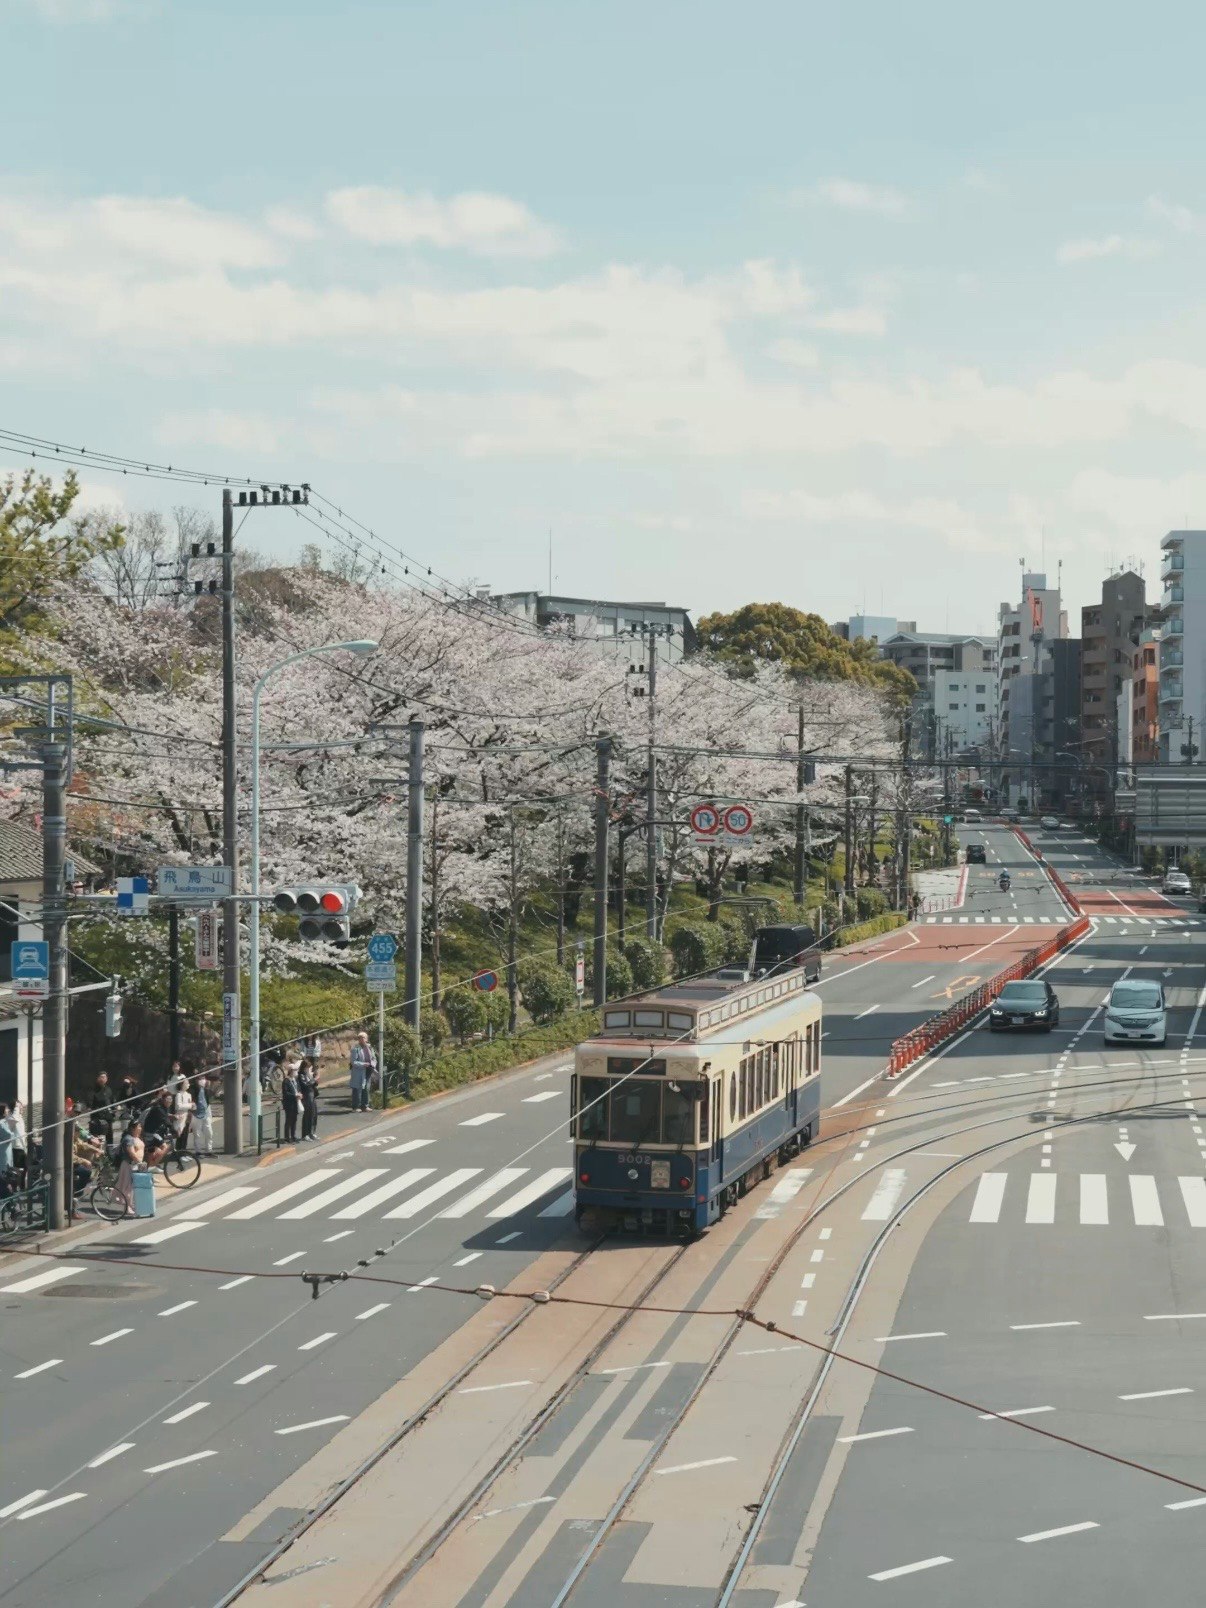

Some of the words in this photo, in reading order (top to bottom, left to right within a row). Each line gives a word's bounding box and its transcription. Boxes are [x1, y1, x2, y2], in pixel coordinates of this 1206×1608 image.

[730, 813, 746, 826] 50
[164, 870, 225, 884] 飛鳥山
[173, 885, 216, 893] Asukayama
[371, 942, 393, 954] 455
[617, 1154, 652, 1165] 9002
